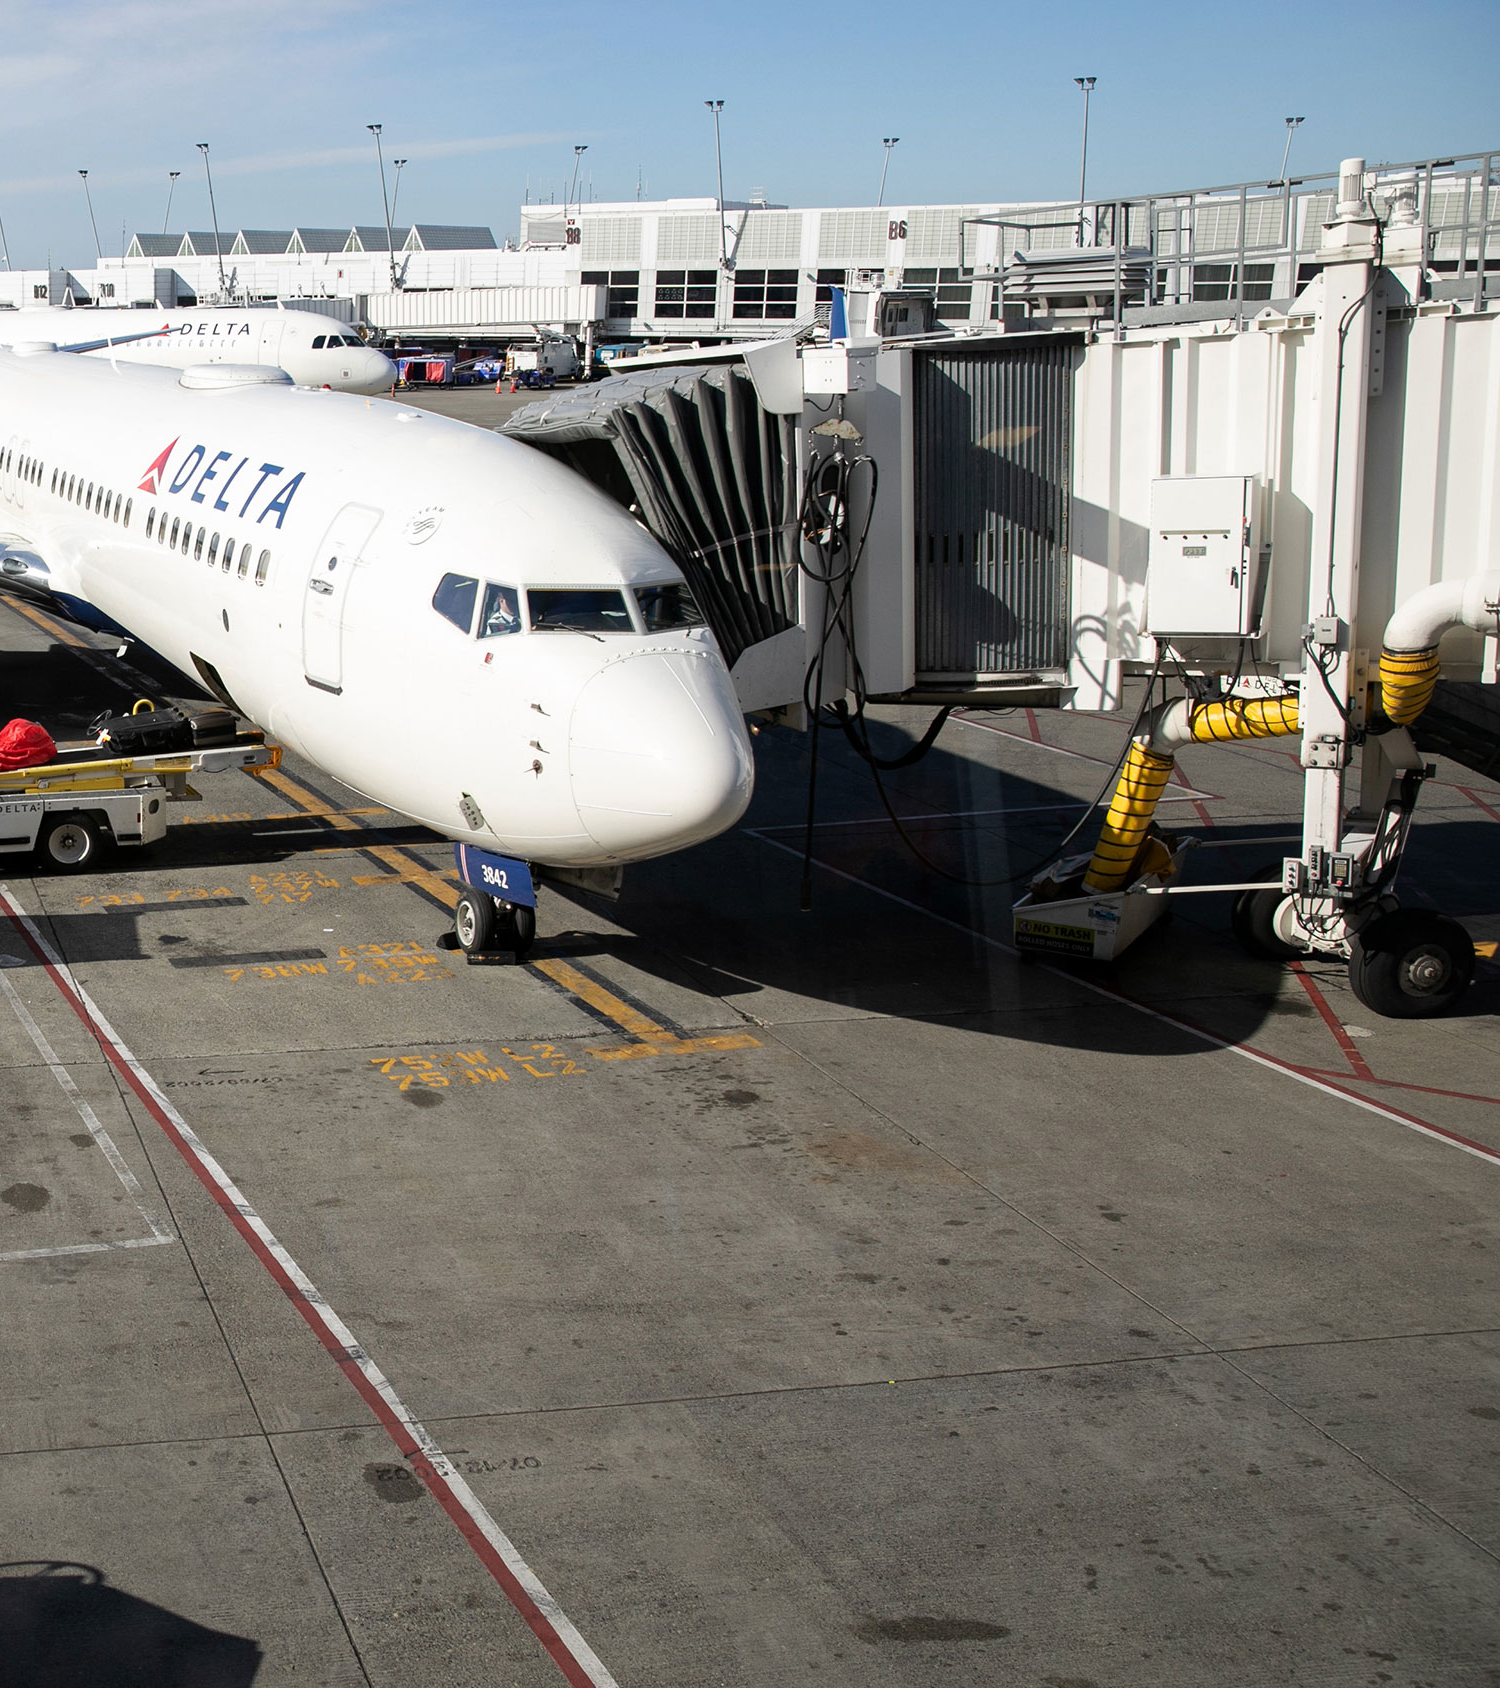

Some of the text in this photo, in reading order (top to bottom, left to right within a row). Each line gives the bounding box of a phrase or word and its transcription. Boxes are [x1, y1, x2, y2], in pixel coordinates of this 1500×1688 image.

[888, 220, 908, 240] B6
[179, 322, 251, 336] DELTA
[169, 444, 306, 529] DELTA
[481, 864, 508, 889] 3842
[75, 893, 146, 907] 733
[1033, 923, 1092, 940] NO TRASH
[1018, 935, 1091, 953] ROLLED HOSES ONLY
